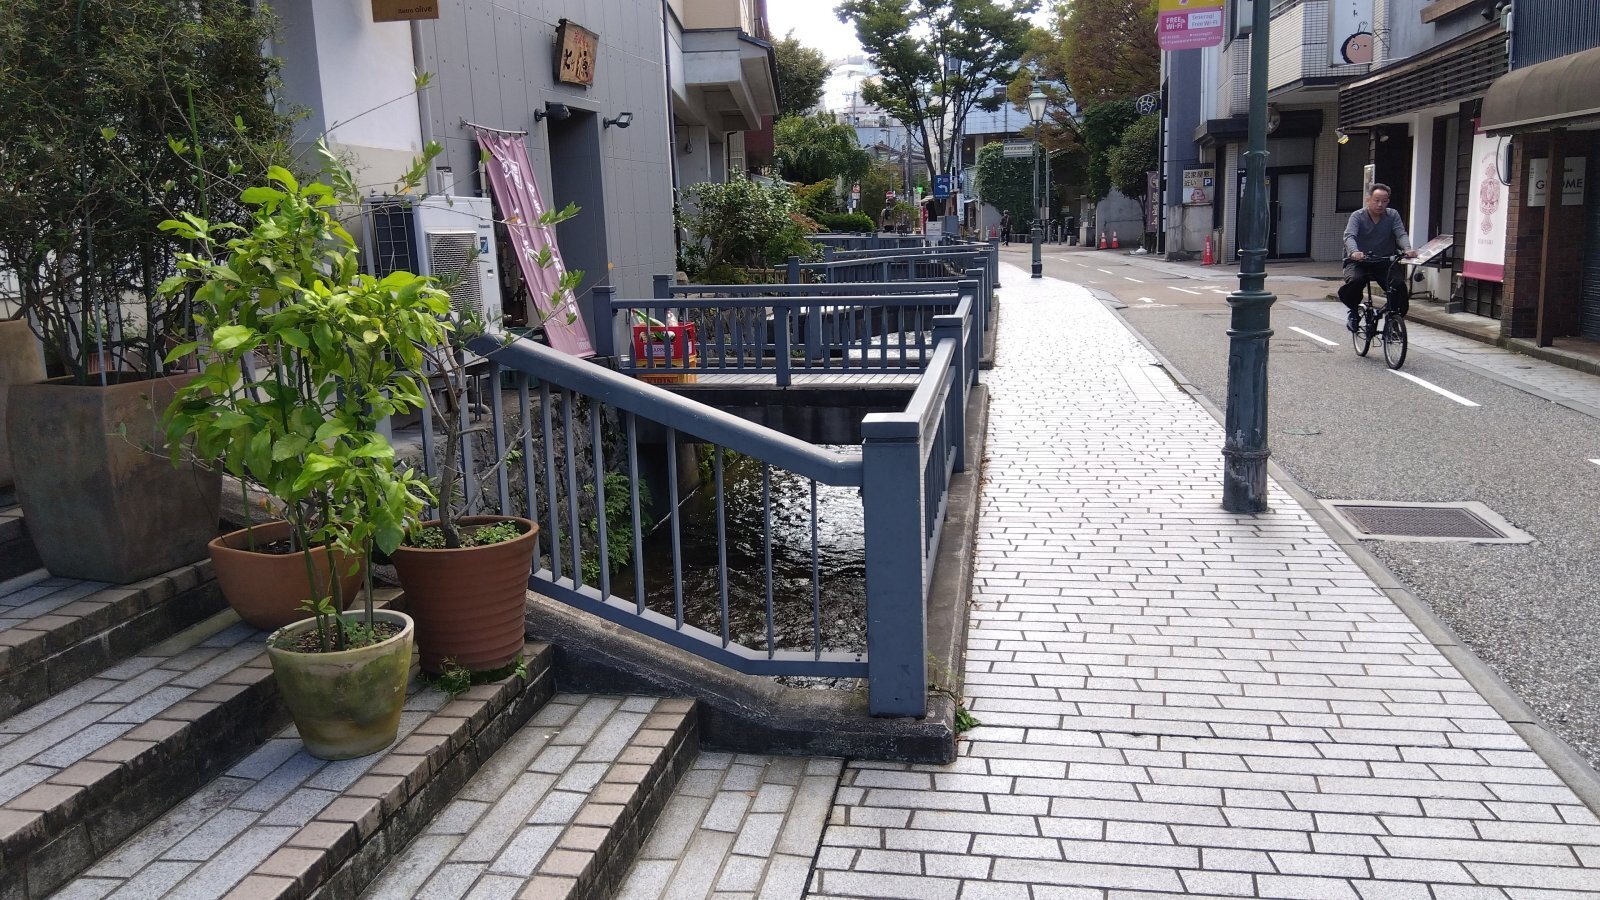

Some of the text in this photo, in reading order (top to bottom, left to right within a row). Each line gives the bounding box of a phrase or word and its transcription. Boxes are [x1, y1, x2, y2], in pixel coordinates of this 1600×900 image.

[1166, 16, 1181, 24] FREE
[1204, 178, 1211, 186] P
[1536, 179, 1583, 189] GME
